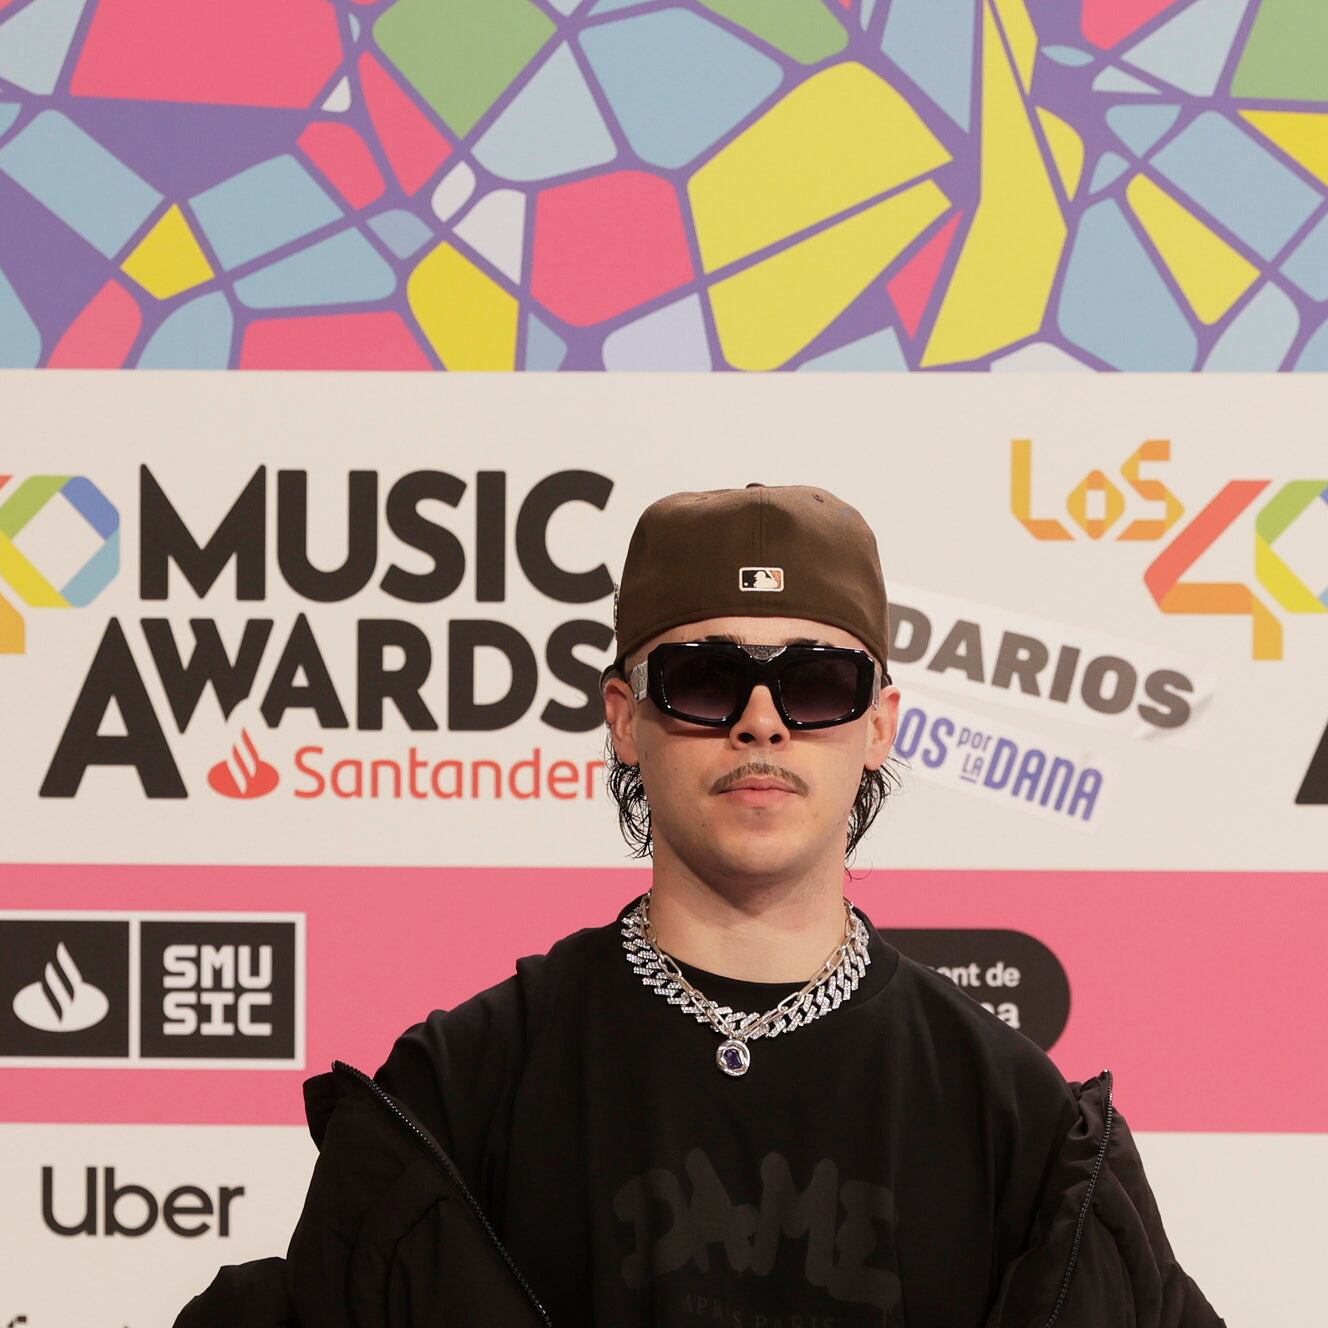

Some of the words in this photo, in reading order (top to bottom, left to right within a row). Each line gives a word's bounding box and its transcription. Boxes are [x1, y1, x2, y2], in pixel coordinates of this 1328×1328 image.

[139, 464, 615, 604] MUSIC
[38, 612, 615, 800] AWARDS
[887, 602, 1194, 729] DARIOS
[293, 744, 608, 800] Santander
[983, 737, 1103, 821] DANA
[985, 961, 1021, 988] de
[41, 1166, 245, 1238] Uber
